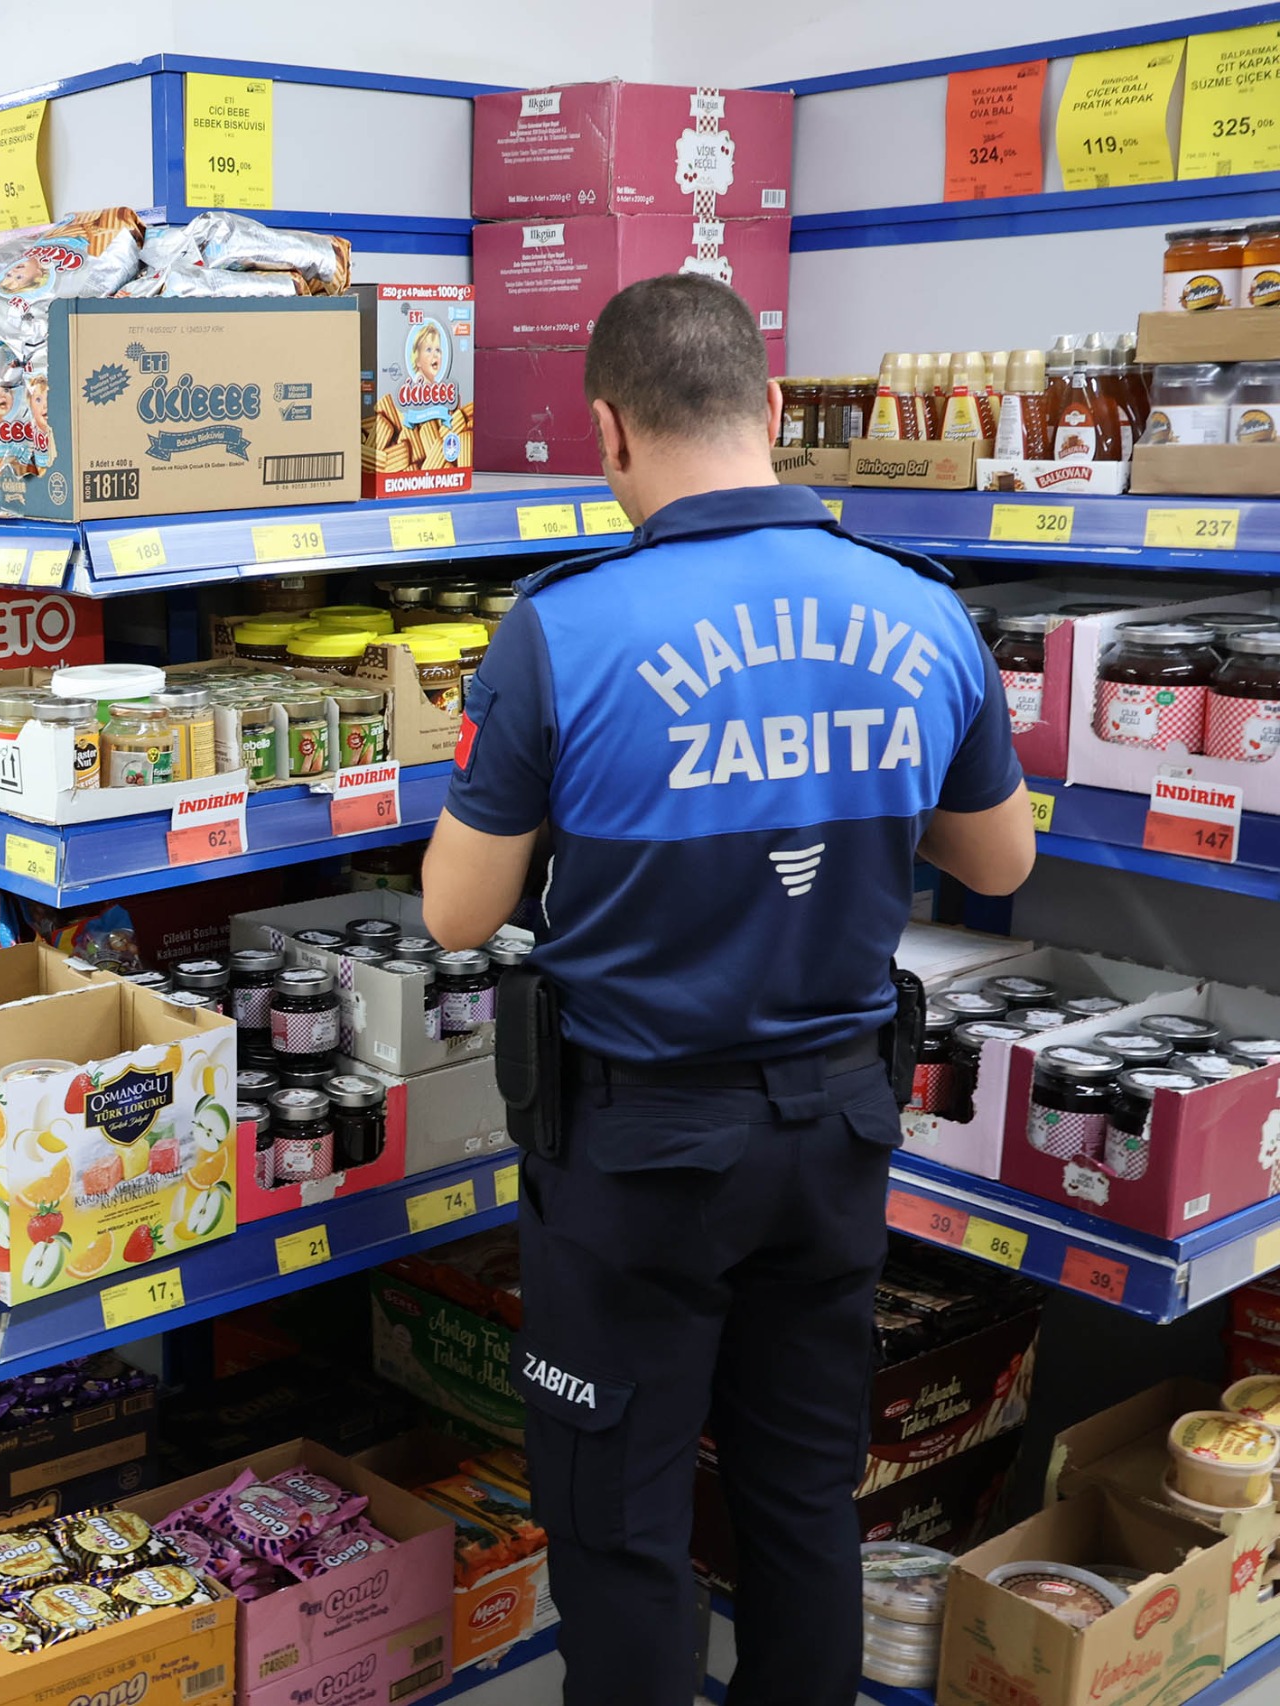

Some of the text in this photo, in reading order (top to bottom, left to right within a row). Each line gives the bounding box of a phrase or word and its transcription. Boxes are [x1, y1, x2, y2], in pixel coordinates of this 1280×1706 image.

[1221, 45, 1279, 61] BALPARMAK
[1239, 54, 1280, 70] KAPAK
[972, 85, 1018, 96] BALPARMAK
[1121, 83, 1148, 93] BALI
[1191, 76, 1233, 91] SÜZME
[973, 95, 1004, 105] YAYLA
[1115, 93, 1154, 105] KAPAK
[227, 107, 250, 118] BEBE
[970, 106, 1014, 119] OVA BALI
[193, 118, 222, 129] BEBEK
[382, 287, 397, 297] 250
[438, 286, 458, 297] 1000
[176, 436, 197, 447] Bebek
[116, 459, 127, 467] 400
[907, 459, 929, 476] Bal
[93, 472, 138, 500] 18113
[384, 472, 465, 493] EKONOMİK PAKET
[1036, 466, 1093, 488] BALKOVAN
[1036, 514, 1068, 531] 320
[1195, 519, 1231, 537] 237
[292, 533, 319, 550] 319
[136, 543, 161, 561] 189
[50, 563, 63, 576] 69
[668, 706, 922, 789] ZABITA
[76, 757, 93, 768] Nut
[338, 767, 397, 789] İNDİRİM
[177, 790, 245, 816] İNDİRİM
[1155, 781, 1236, 810] İNDİRİM
[376, 799, 393, 817] 67
[1194, 829, 1230, 850] 147
[90, 1075, 169, 1112] OSMANOĞLU
[94, 1095, 167, 1123] TÜRK LOKUMU
[310, 1239, 327, 1256] 21
[522, 1351, 597, 1409] ZABITA
[284, 1477, 331, 1503] Gong
[87, 1517, 131, 1550] Gong
[323, 1538, 370, 1569] Gong
[133, 1569, 174, 1600] Gong
[324, 1568, 390, 1619] Gong
[53, 1588, 100, 1616] Gong
[314, 1653, 377, 1706] Gong
